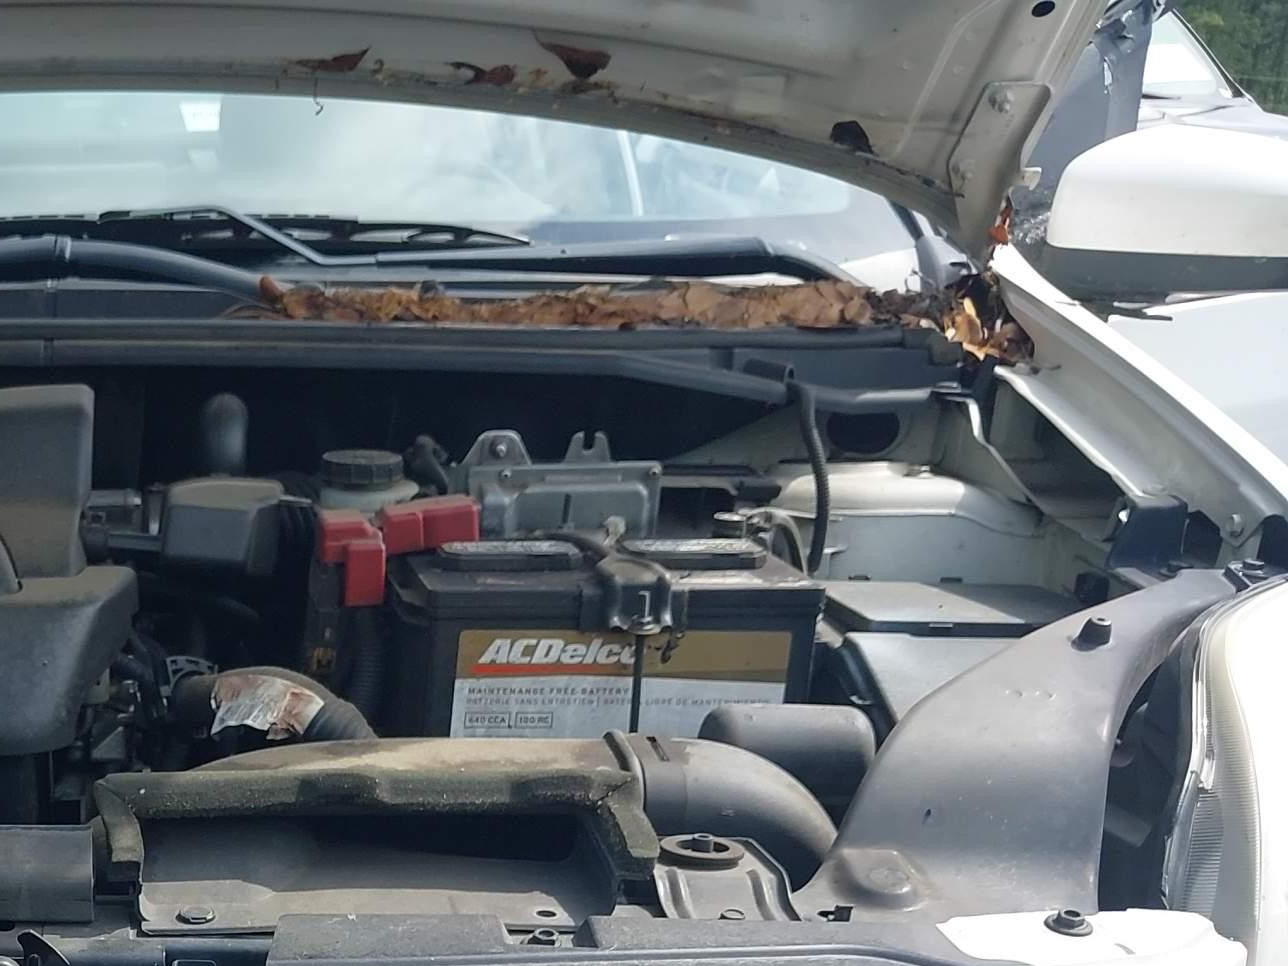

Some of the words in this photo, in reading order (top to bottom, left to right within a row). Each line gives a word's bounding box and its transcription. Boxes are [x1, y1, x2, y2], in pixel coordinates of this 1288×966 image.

[467, 687, 545, 696] MAINTENANCE
[549, 687, 576, 696] FREE
[580, 687, 630, 696] BATTERY
